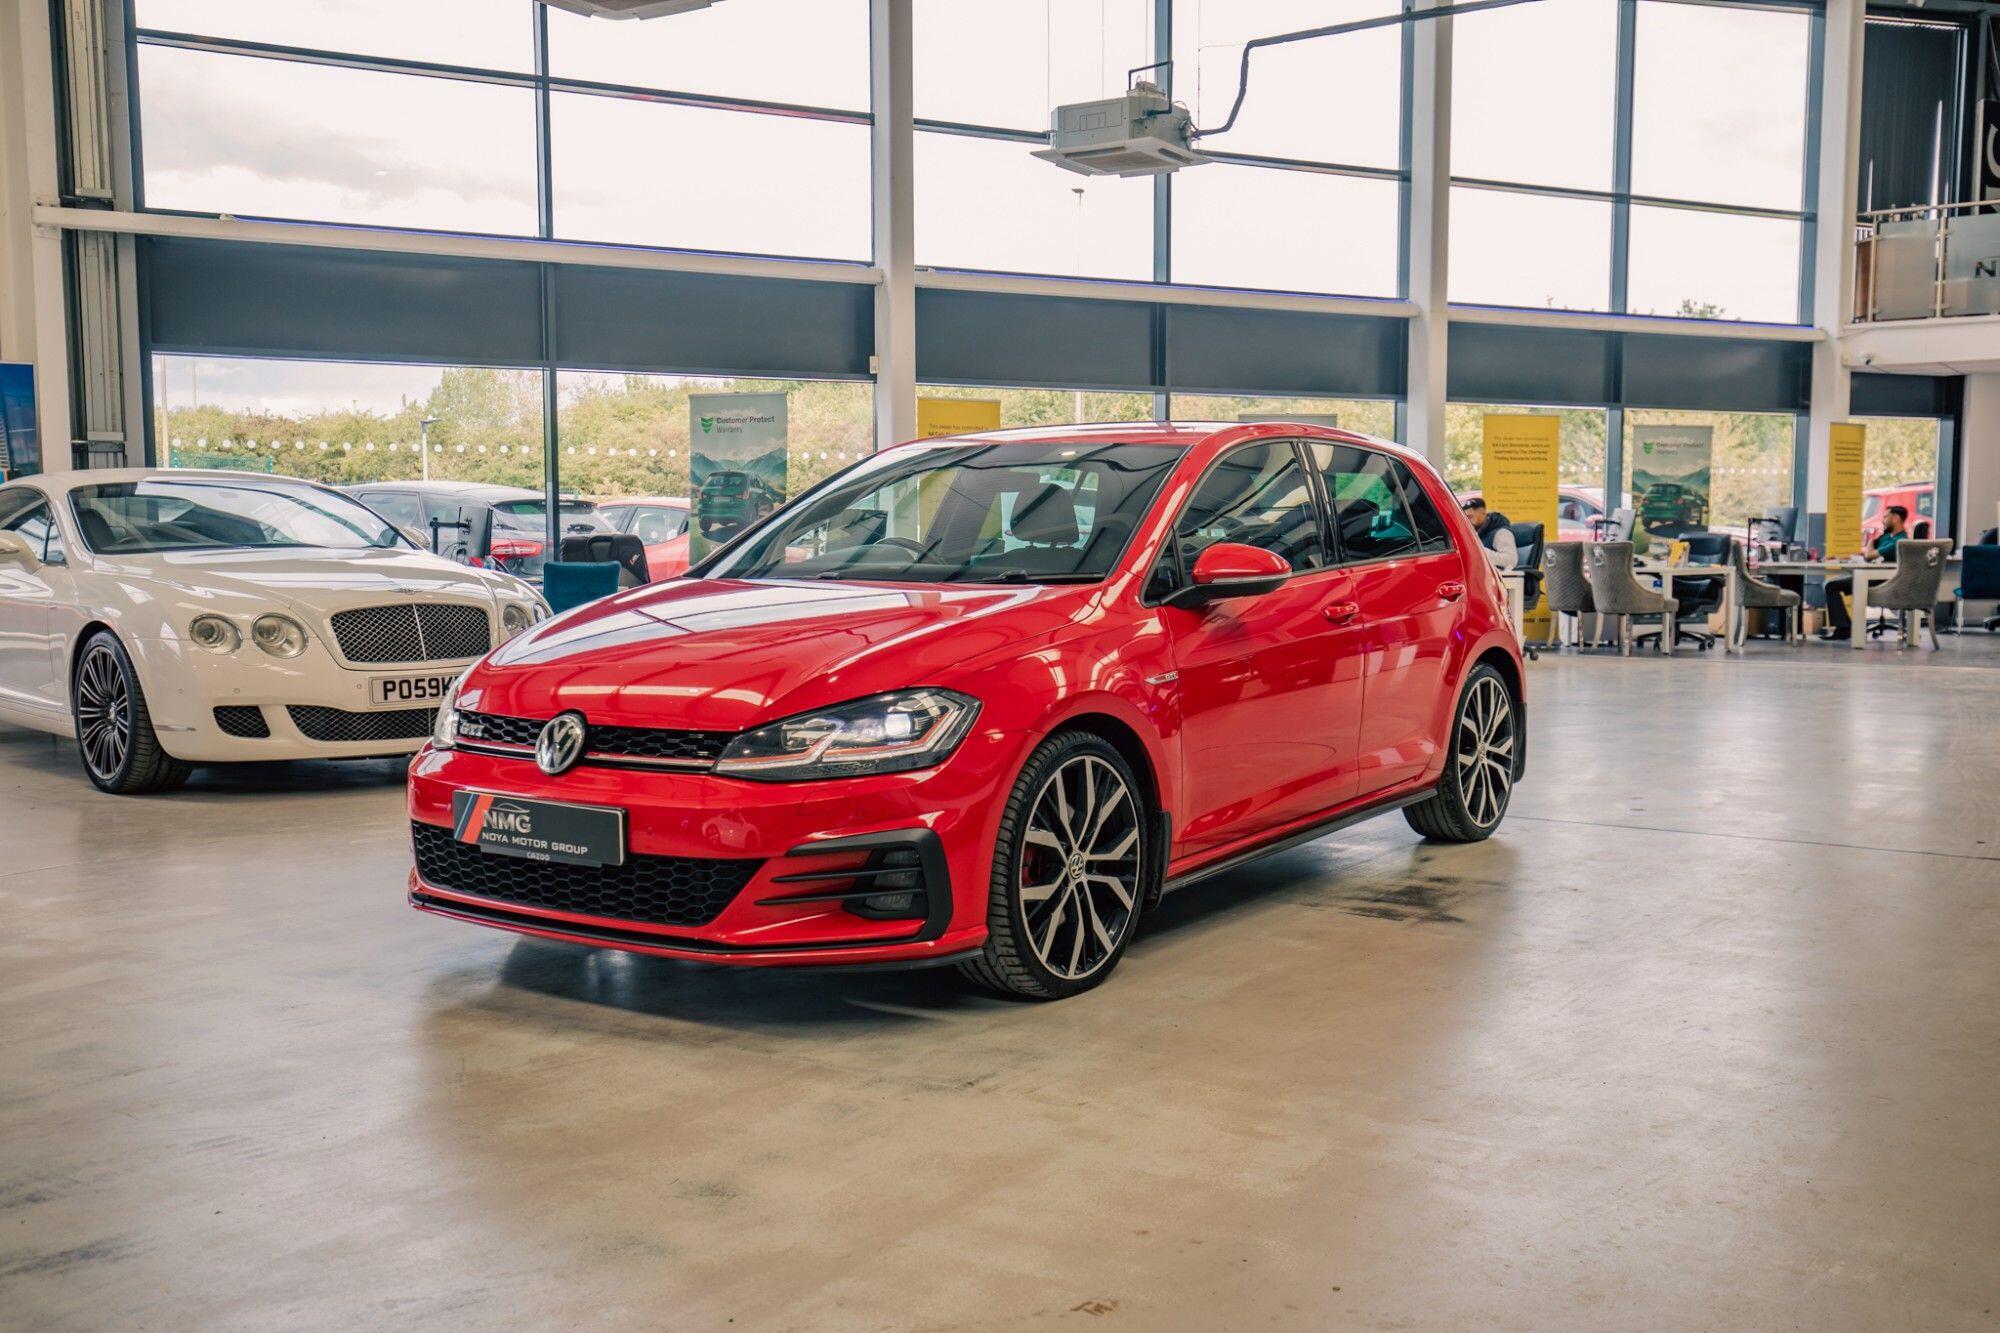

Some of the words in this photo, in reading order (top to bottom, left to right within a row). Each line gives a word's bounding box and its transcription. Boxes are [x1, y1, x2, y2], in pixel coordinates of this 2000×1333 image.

[716, 416, 748, 424] Customer
[749, 415, 775, 423] Protect
[716, 426, 743, 434] Warranty
[383, 677, 457, 700] PO59K
[483, 809, 532, 833] NMG
[481, 831, 509, 843] NOYA
[512, 836, 548, 849] MOTOR
[551, 841, 588, 855] GROUP
[526, 851, 551, 861] CAZOO
